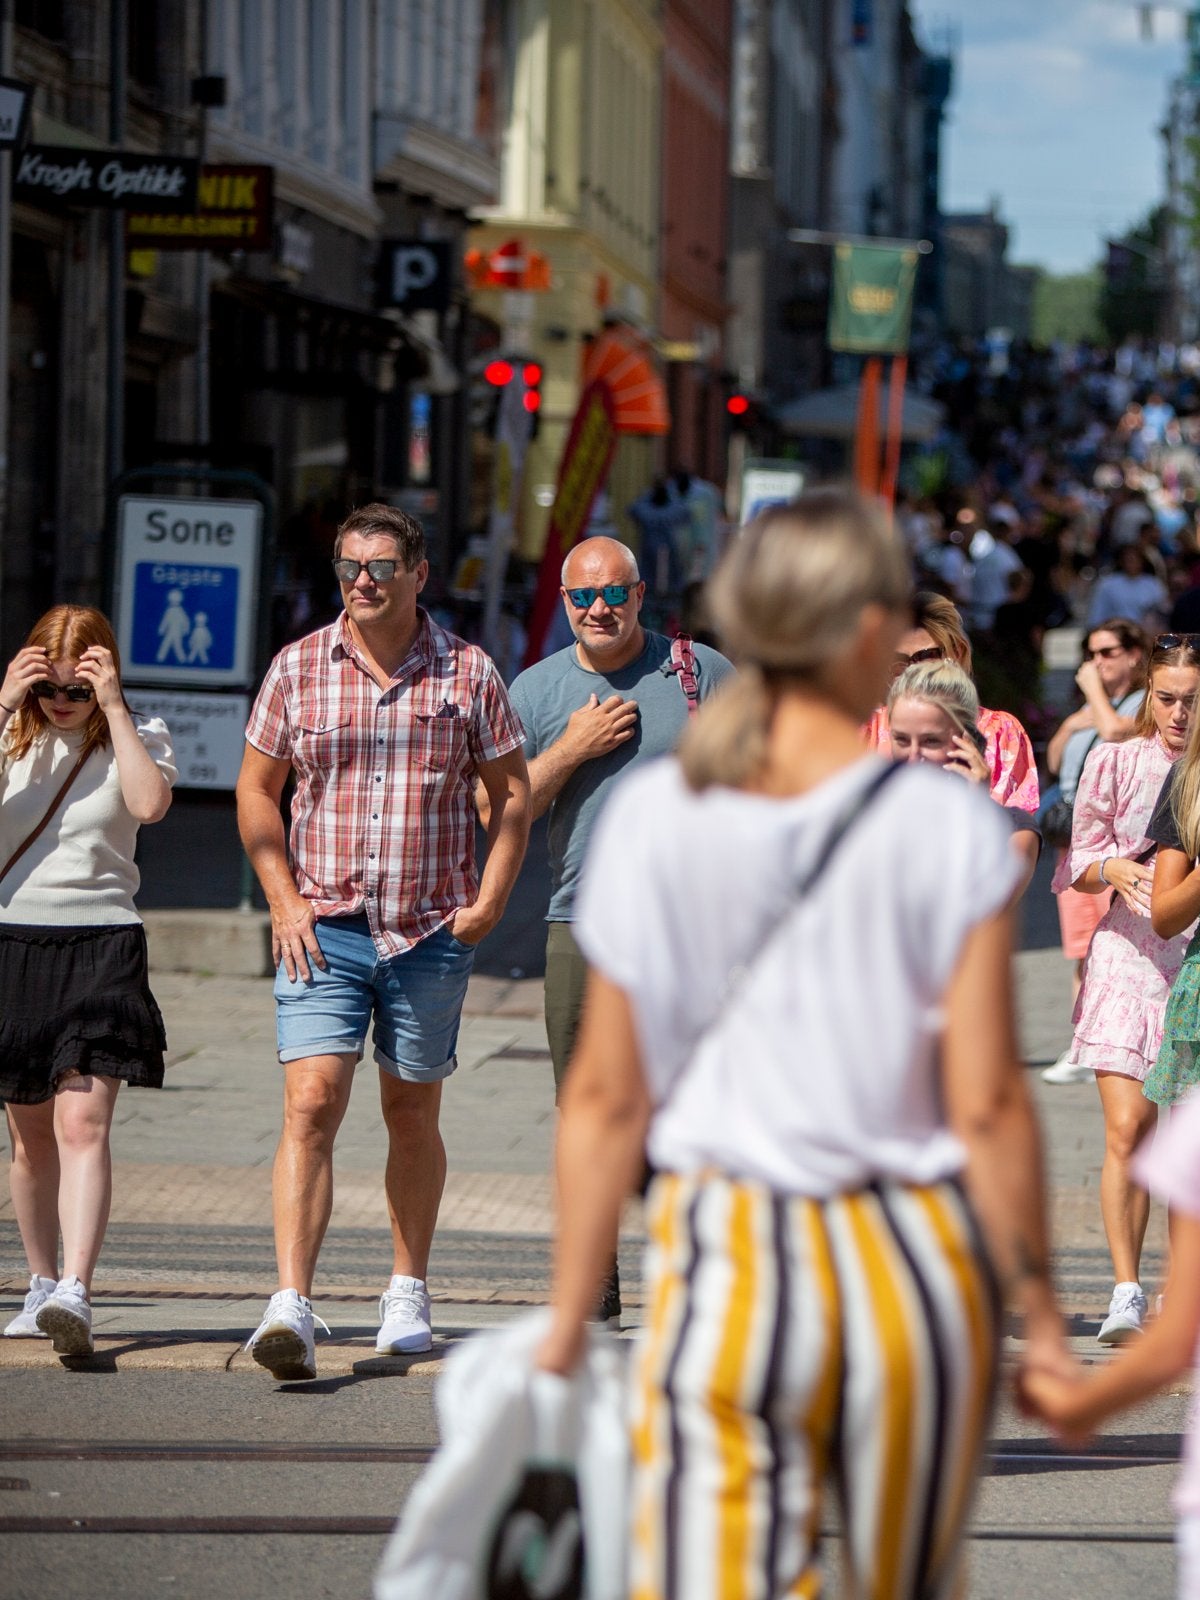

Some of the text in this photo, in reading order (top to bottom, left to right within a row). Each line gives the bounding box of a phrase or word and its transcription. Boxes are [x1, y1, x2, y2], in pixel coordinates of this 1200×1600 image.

[17, 153, 186, 198] Krogh Optikk
[145, 509, 235, 546] Sone
